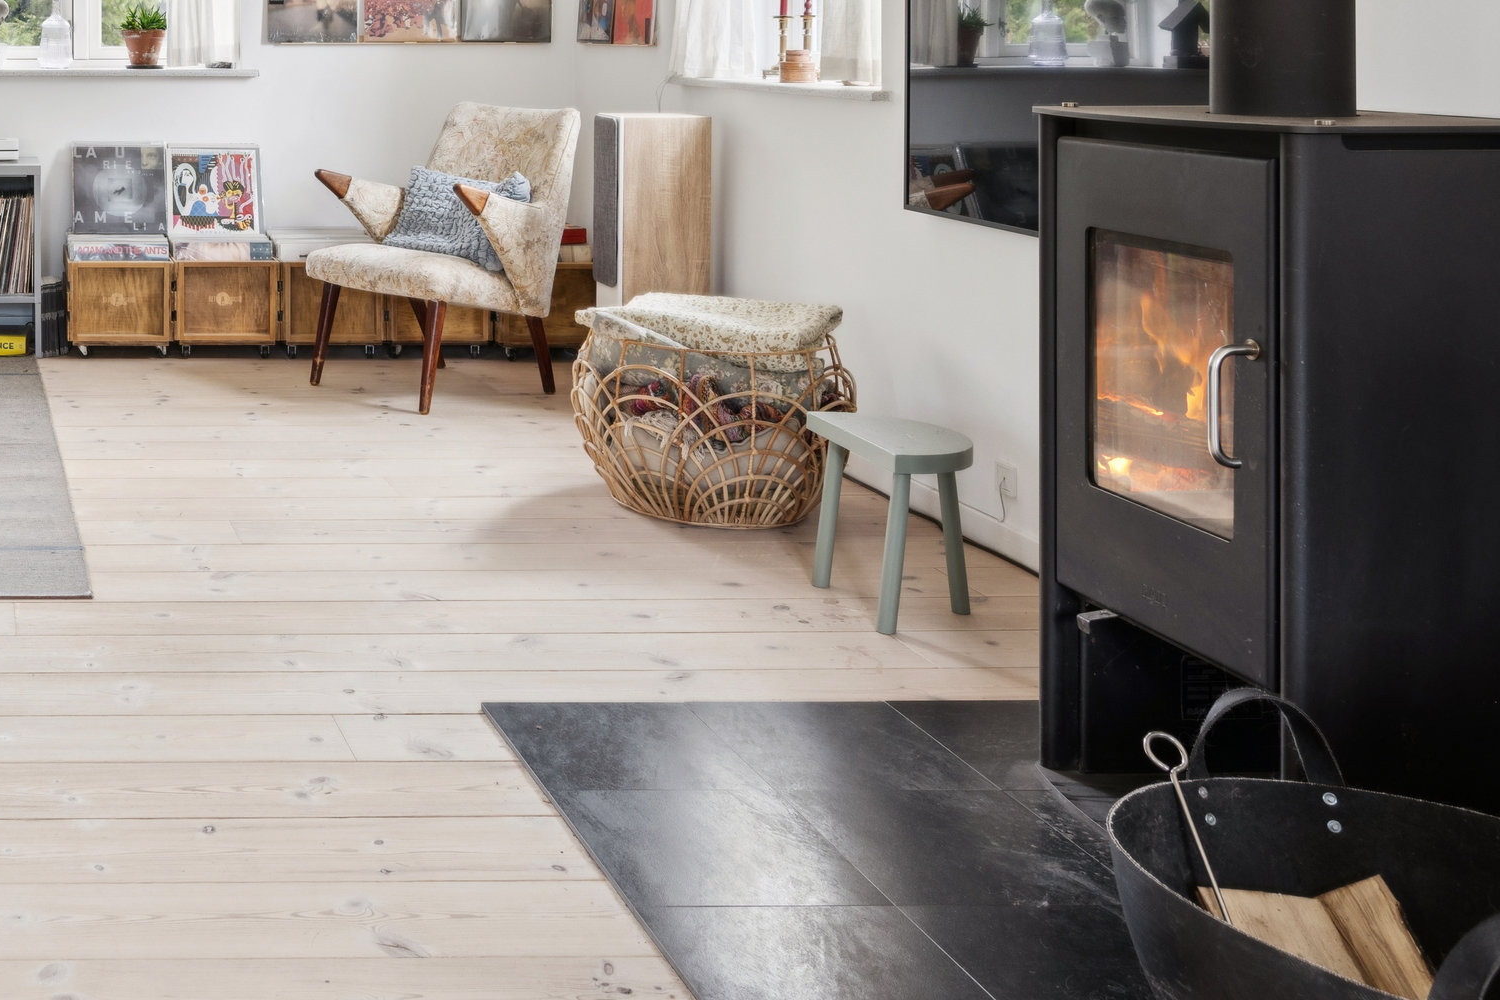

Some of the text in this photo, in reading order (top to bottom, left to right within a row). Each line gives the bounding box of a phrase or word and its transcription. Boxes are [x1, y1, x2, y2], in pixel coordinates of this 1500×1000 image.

[77, 246, 168, 254] ADAM AND THE ANTS
